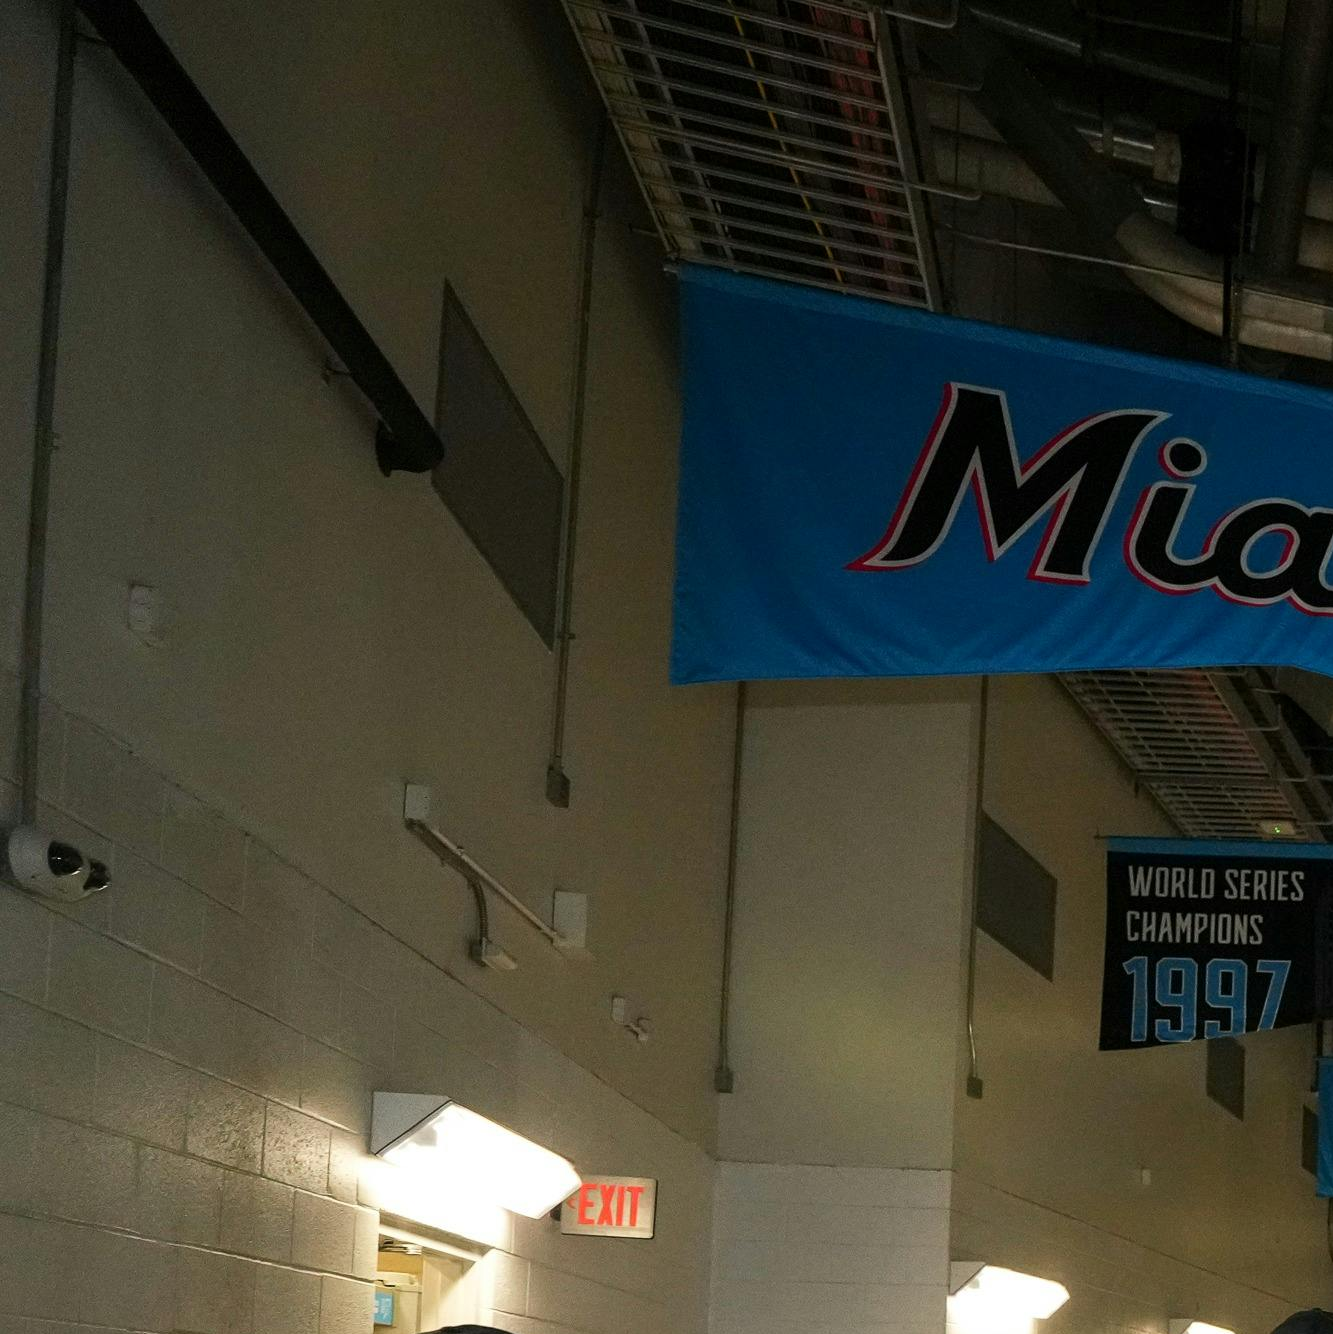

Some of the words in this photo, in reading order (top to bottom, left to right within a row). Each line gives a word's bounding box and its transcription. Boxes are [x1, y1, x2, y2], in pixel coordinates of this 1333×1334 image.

[1128, 865, 1215, 899] WORLD
[1224, 868, 1305, 901] SERIES
[1126, 910, 1264, 944] CHAMPIONS
[1122, 956, 1292, 1042] 1997
[577, 1183, 646, 1227] EXIT
